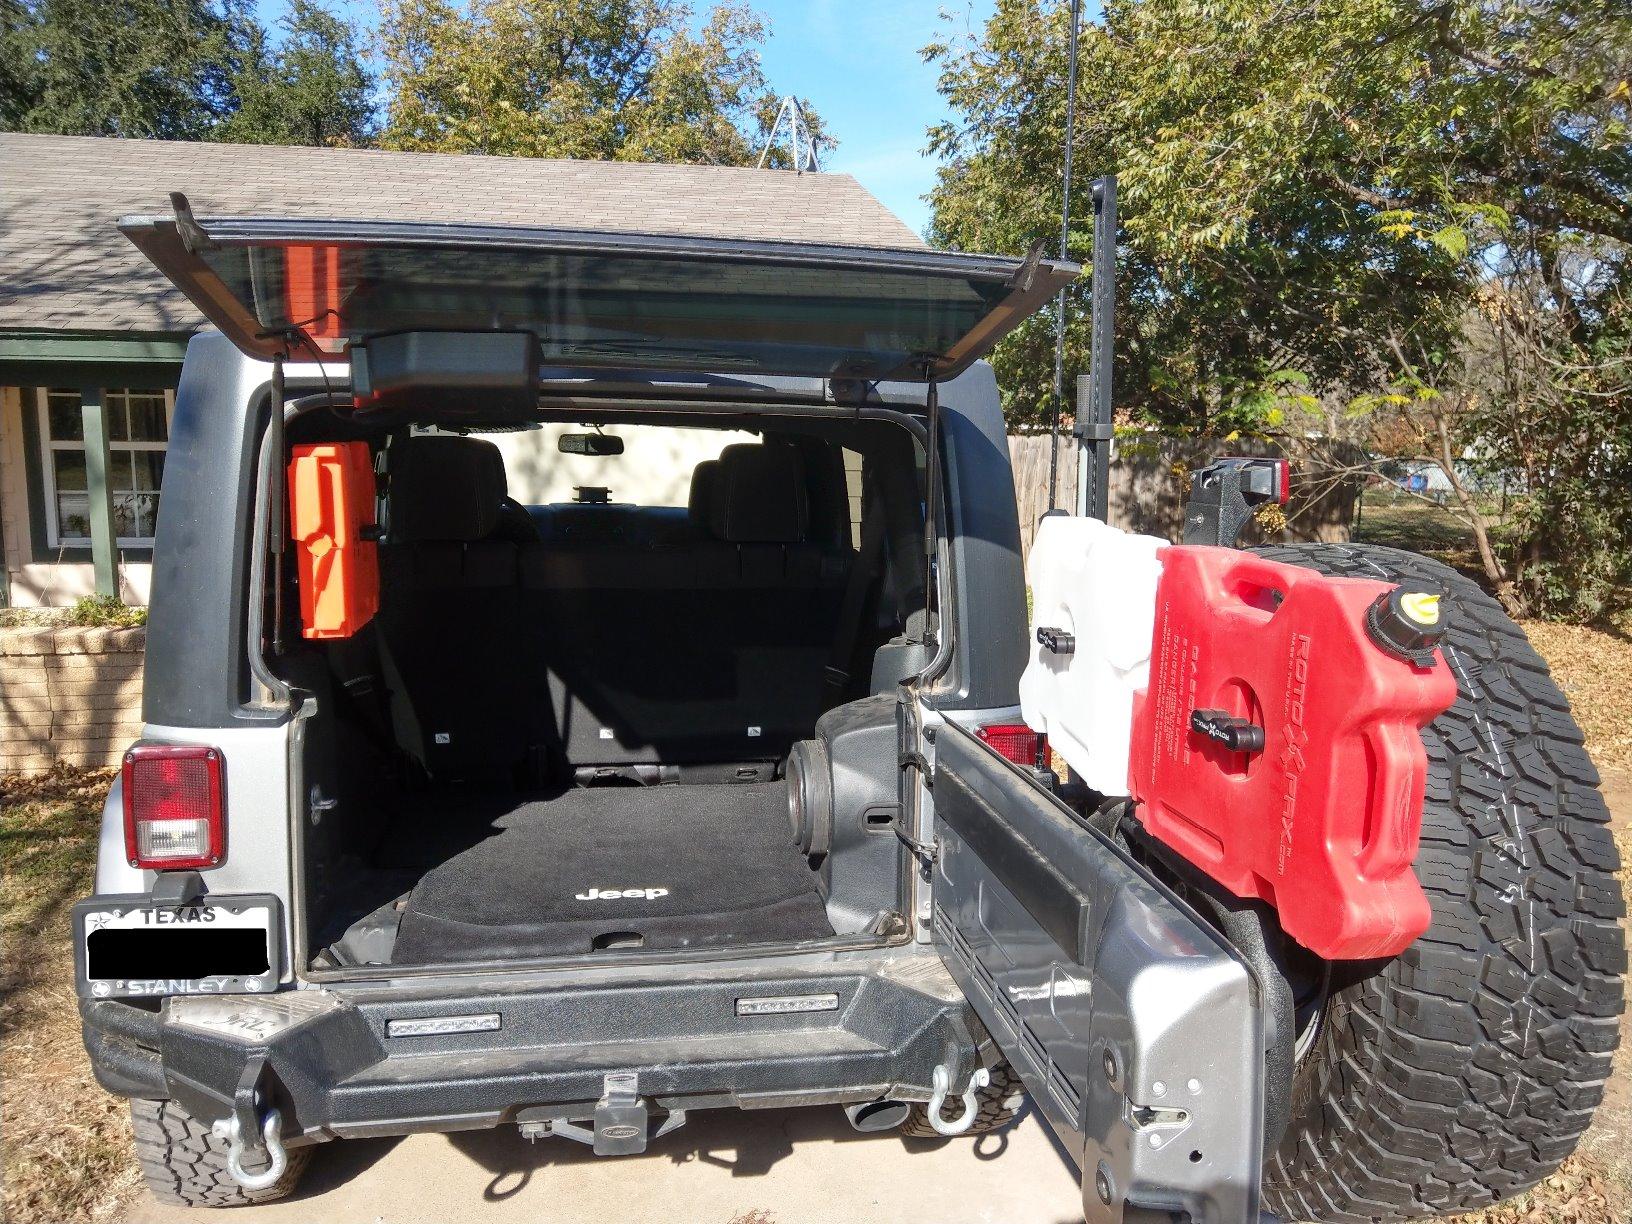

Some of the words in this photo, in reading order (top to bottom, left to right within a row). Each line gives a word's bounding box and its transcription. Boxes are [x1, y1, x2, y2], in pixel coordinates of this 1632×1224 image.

[1289, 632, 1297, 658] MADE
[1291, 634, 1311, 727] ROTO
[1215, 729, 1230, 741] ROTO
[575, 888, 669, 900] Jeep
[140, 906, 216, 925] TEXAS
[128, 978, 229, 994] STANLEY
